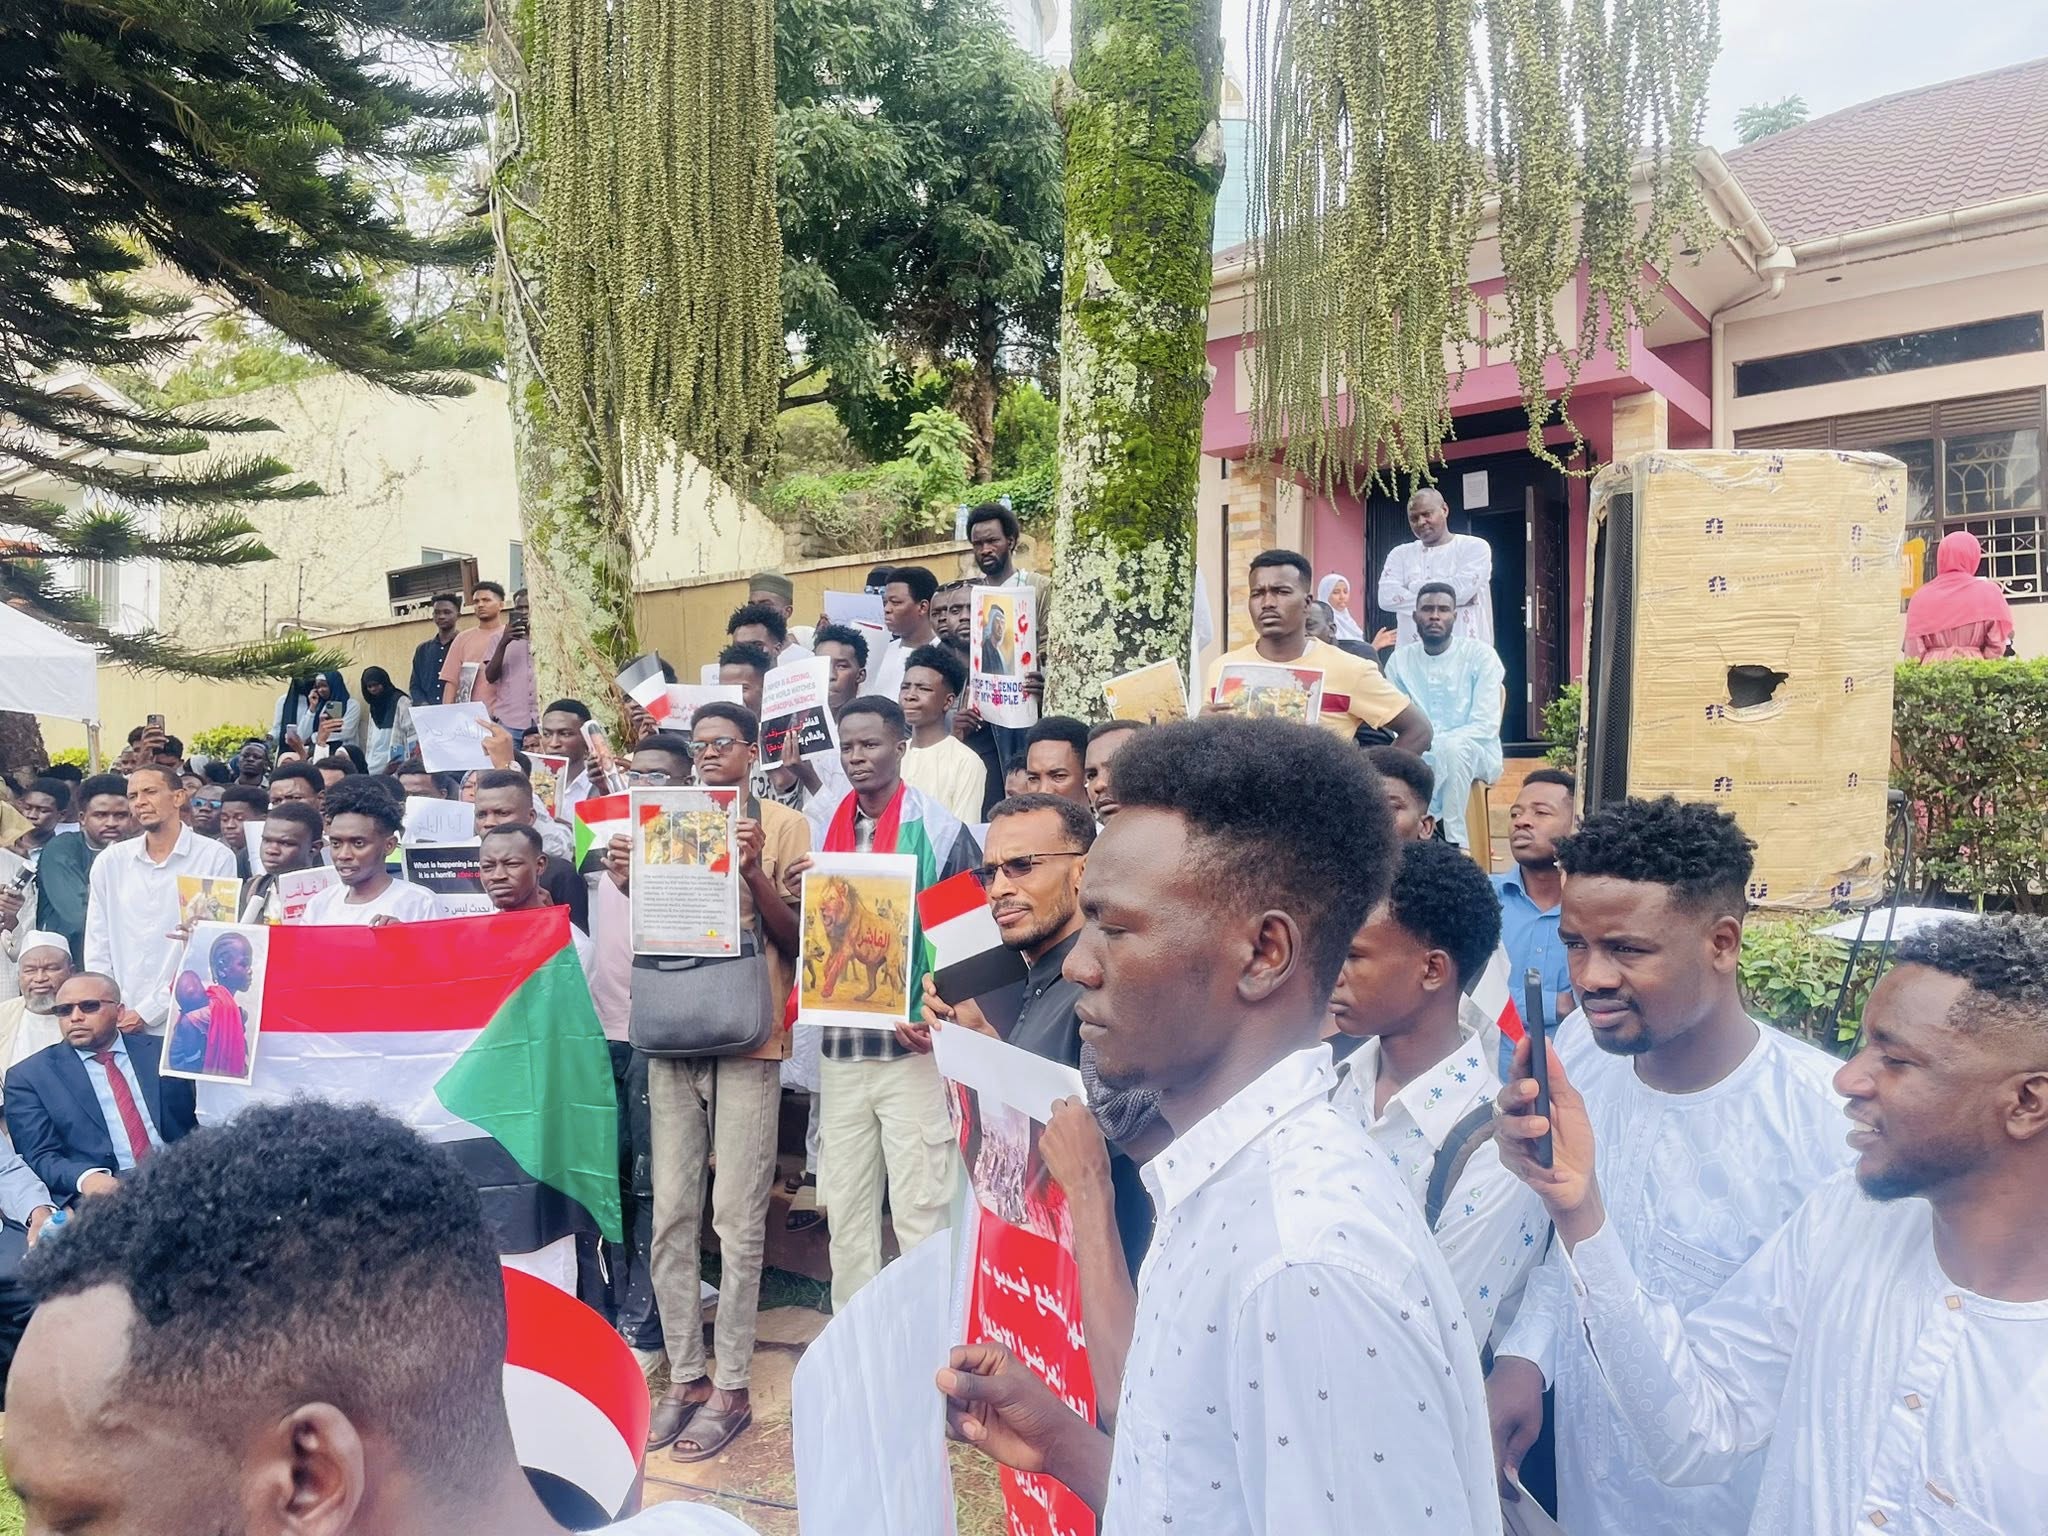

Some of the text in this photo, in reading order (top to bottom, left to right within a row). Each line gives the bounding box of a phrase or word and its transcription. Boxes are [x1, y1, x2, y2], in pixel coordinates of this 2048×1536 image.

[991, 693, 1019, 705] PEOPLE
[413, 861, 430, 869] What
[437, 860, 467, 870] happening
[451, 903, 468, 915] ليس
[856, 927, 891, 950] الفاشر
